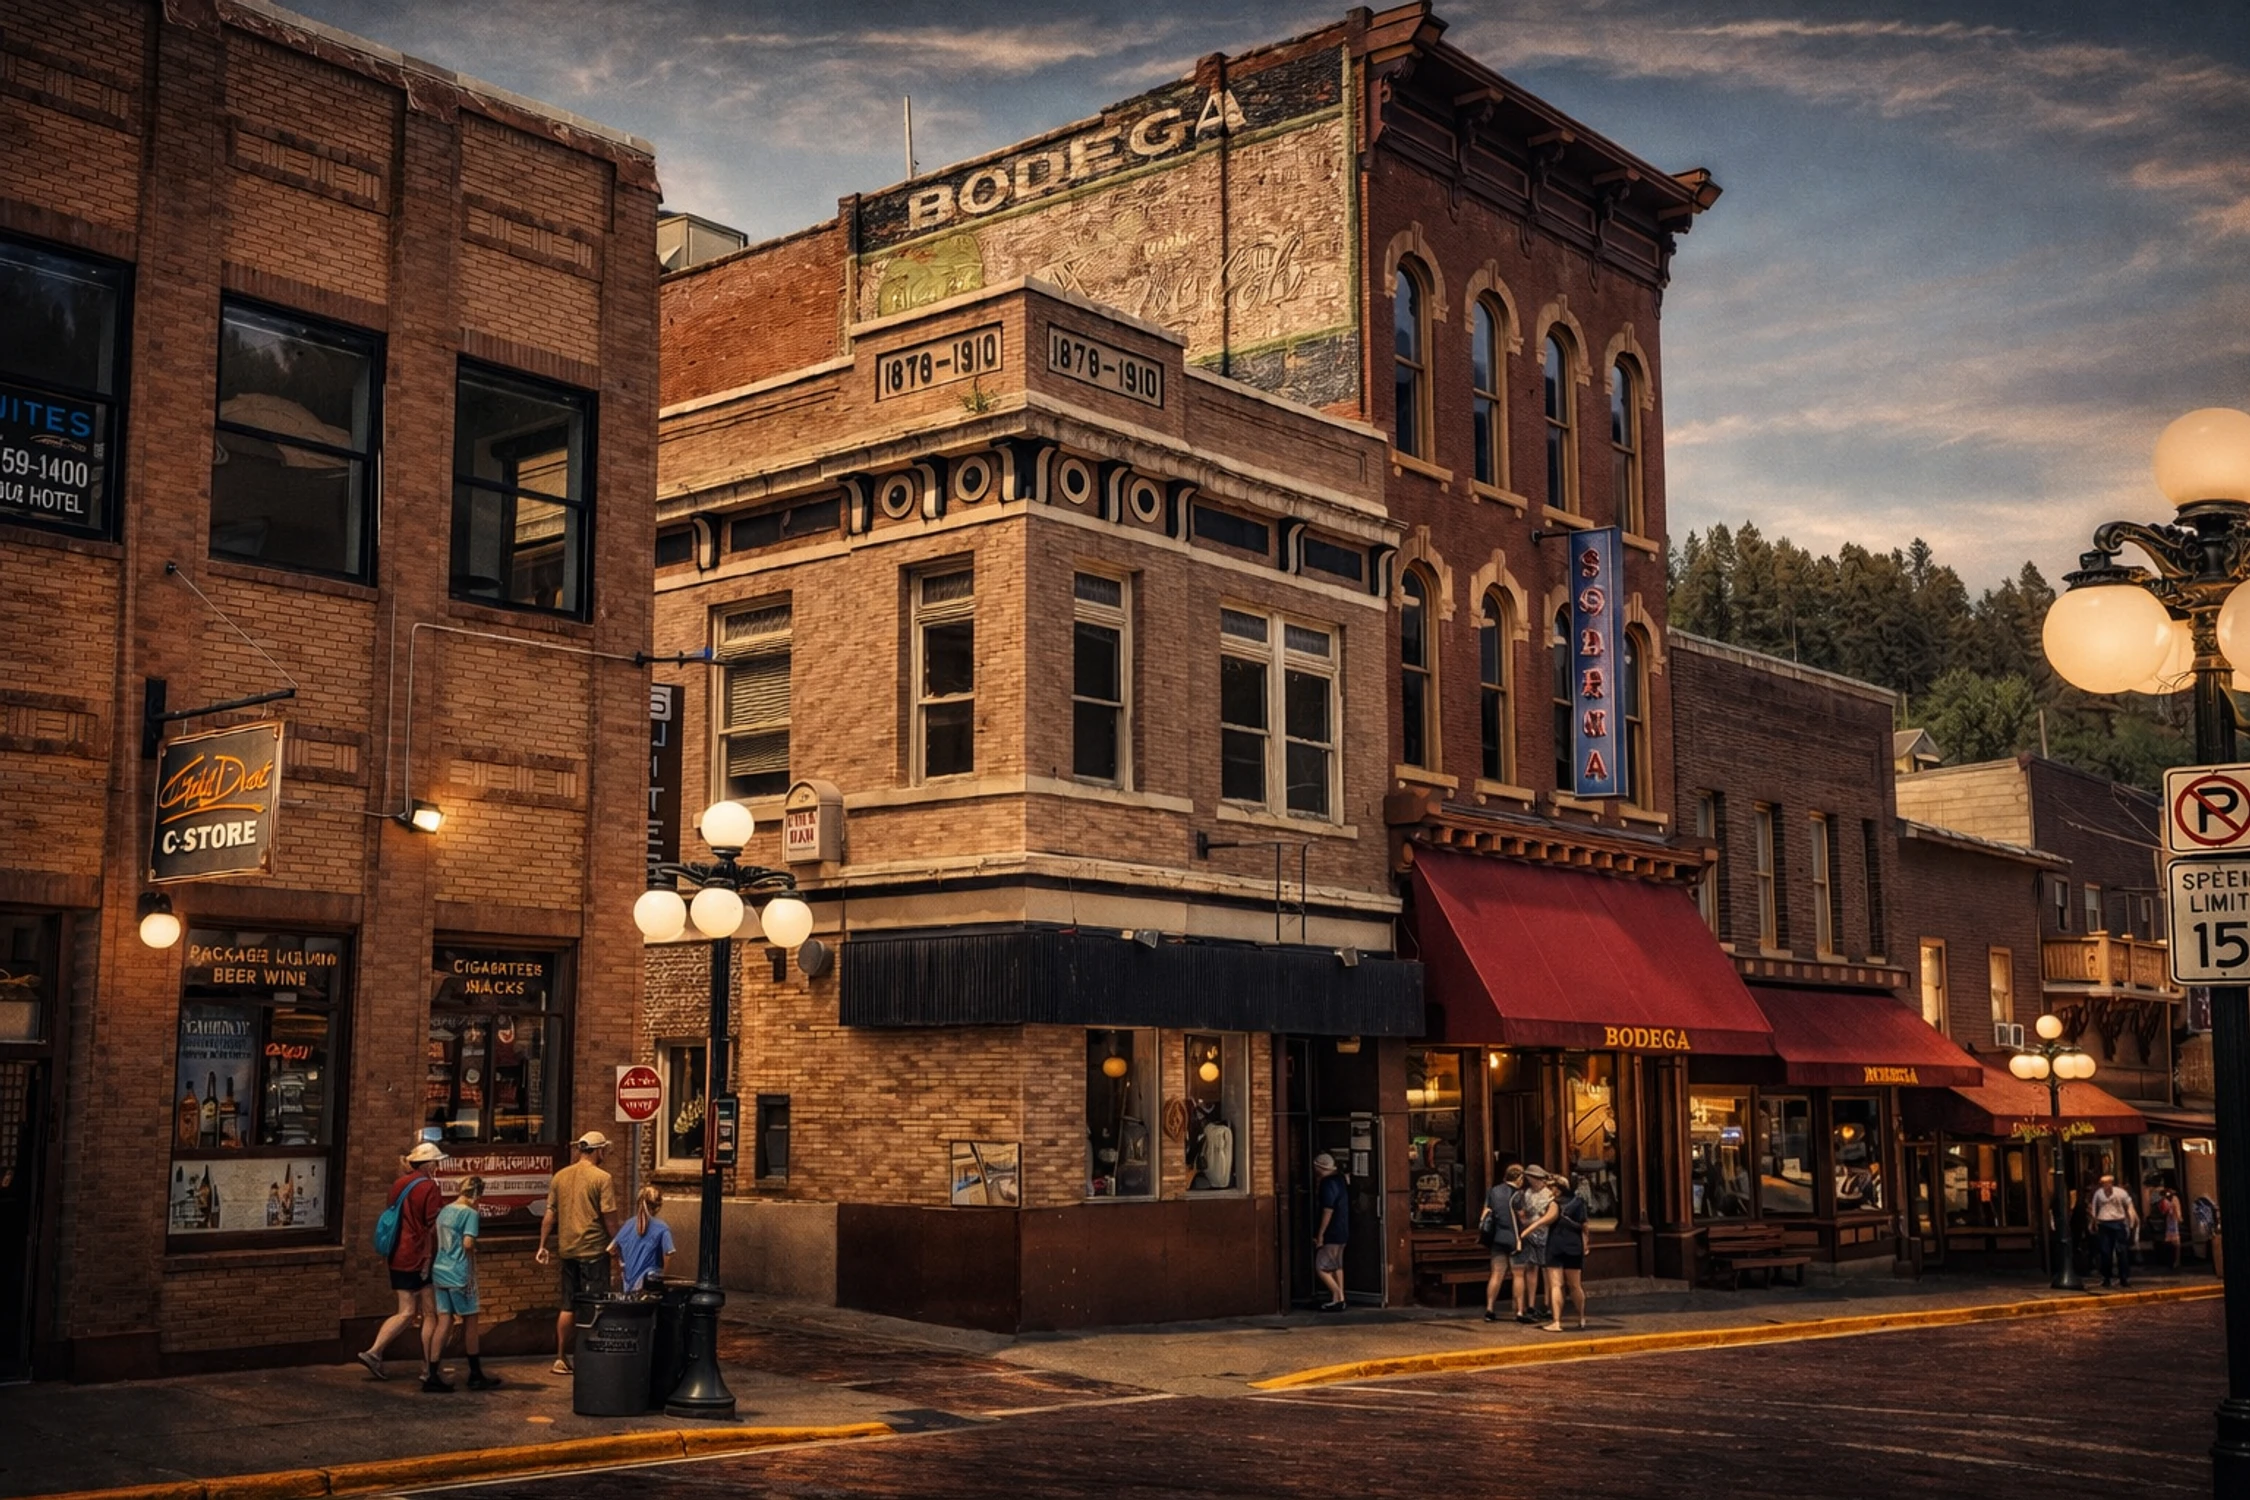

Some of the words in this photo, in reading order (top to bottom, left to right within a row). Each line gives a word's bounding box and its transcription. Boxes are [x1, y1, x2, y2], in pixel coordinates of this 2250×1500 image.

[908, 89, 1247, 232] BODEGA
[885, 334, 996, 394] 1878-1910
[1052, 335, 1157, 399] 1878-1910
[2, 447, 88, 488] 59-1400
[29, 486, 84, 514] HOTEL
[162, 820, 257, 855] C-STORE
[2190, 892, 2249, 913] LIMIT
[2193, 921, 2249, 969] 15
[213, 967, 256, 984] BEER
[264, 969, 307, 986] WINE
[1604, 1026, 1691, 1050] BODEGA
